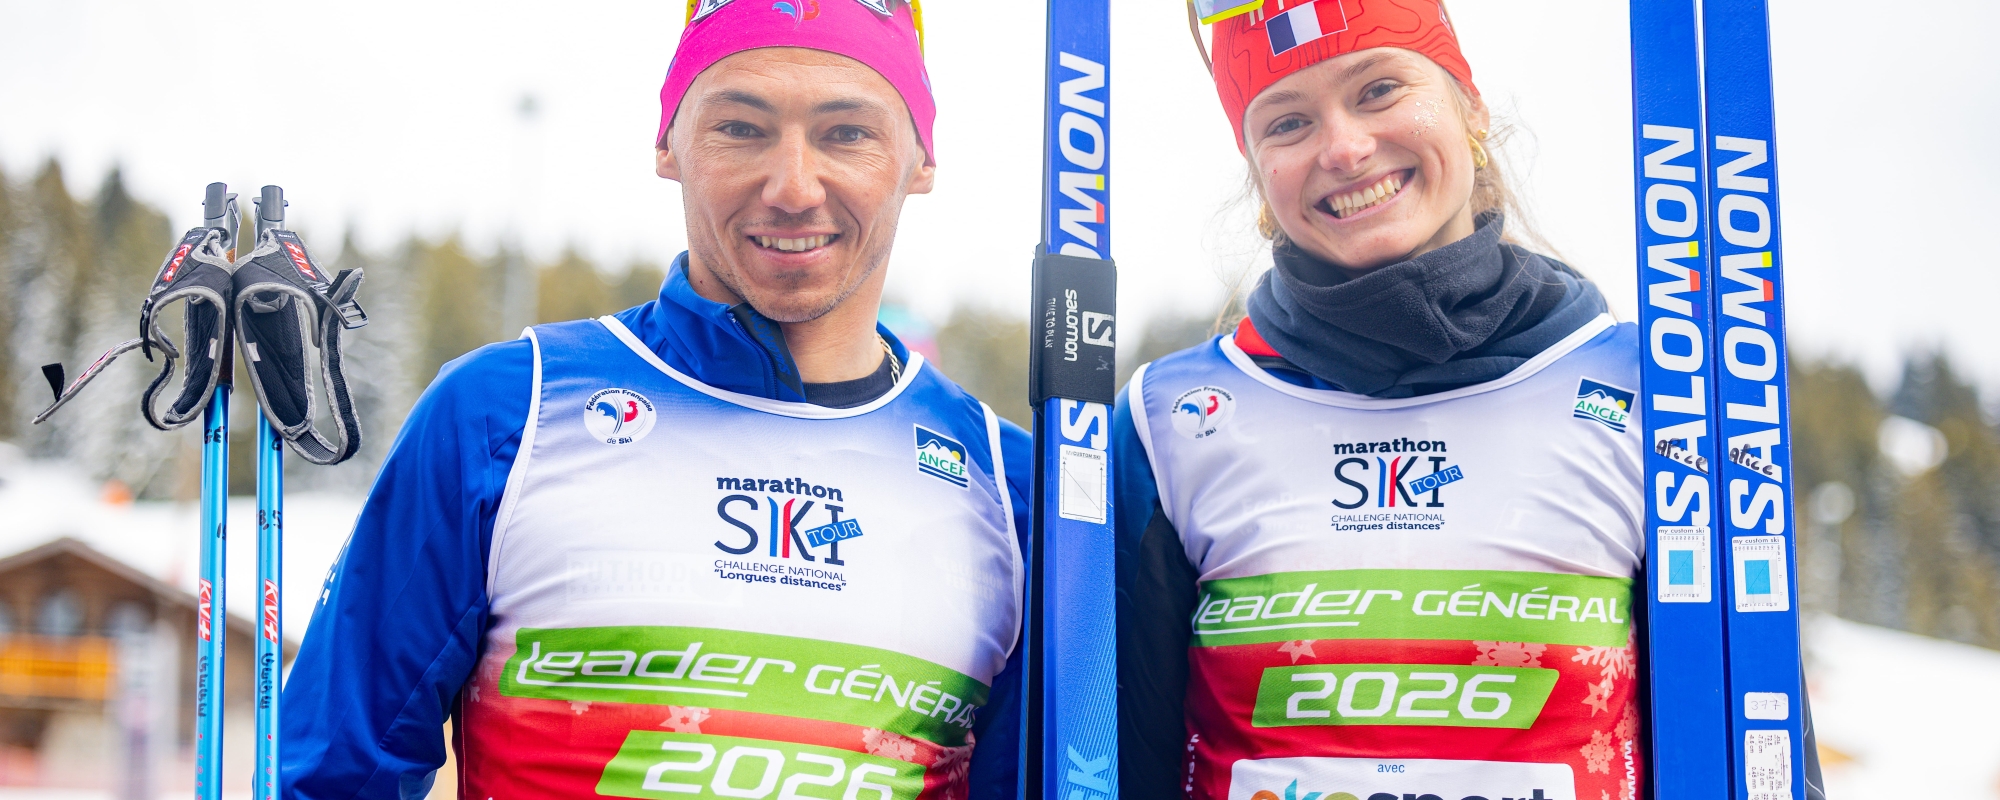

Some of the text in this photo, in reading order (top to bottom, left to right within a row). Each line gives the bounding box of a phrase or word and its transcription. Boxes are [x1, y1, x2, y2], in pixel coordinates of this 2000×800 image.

[1059, 51, 1108, 450] SMON
[1064, 289, 1079, 361] salomon
[1643, 124, 1710, 526] SALOMON
[1715, 135, 1784, 535] SALOMON
[1575, 400, 1627, 422] ANCEF
[619, 436, 633, 444] Ski
[1205, 427, 1217, 436] Ski
[1333, 437, 1447, 454] marathon
[918, 451, 966, 476] ANCEF
[717, 477, 843, 502] marathon
[1411, 467, 1462, 493] TOUR
[1331, 513, 1445, 523] CHALLENGE NATIONAL
[806, 521, 861, 545] TOUR
[714, 559, 846, 582] CHALLENGE NATIONAL
[199, 578, 212, 642] KV+
[264, 578, 278, 644] KV+
[1412, 583, 1624, 624] GÉNÉRAL
[1286, 672, 1516, 720] 2026
[642, 741, 897, 800] 2026
[1377, 763, 1405, 774] avec
